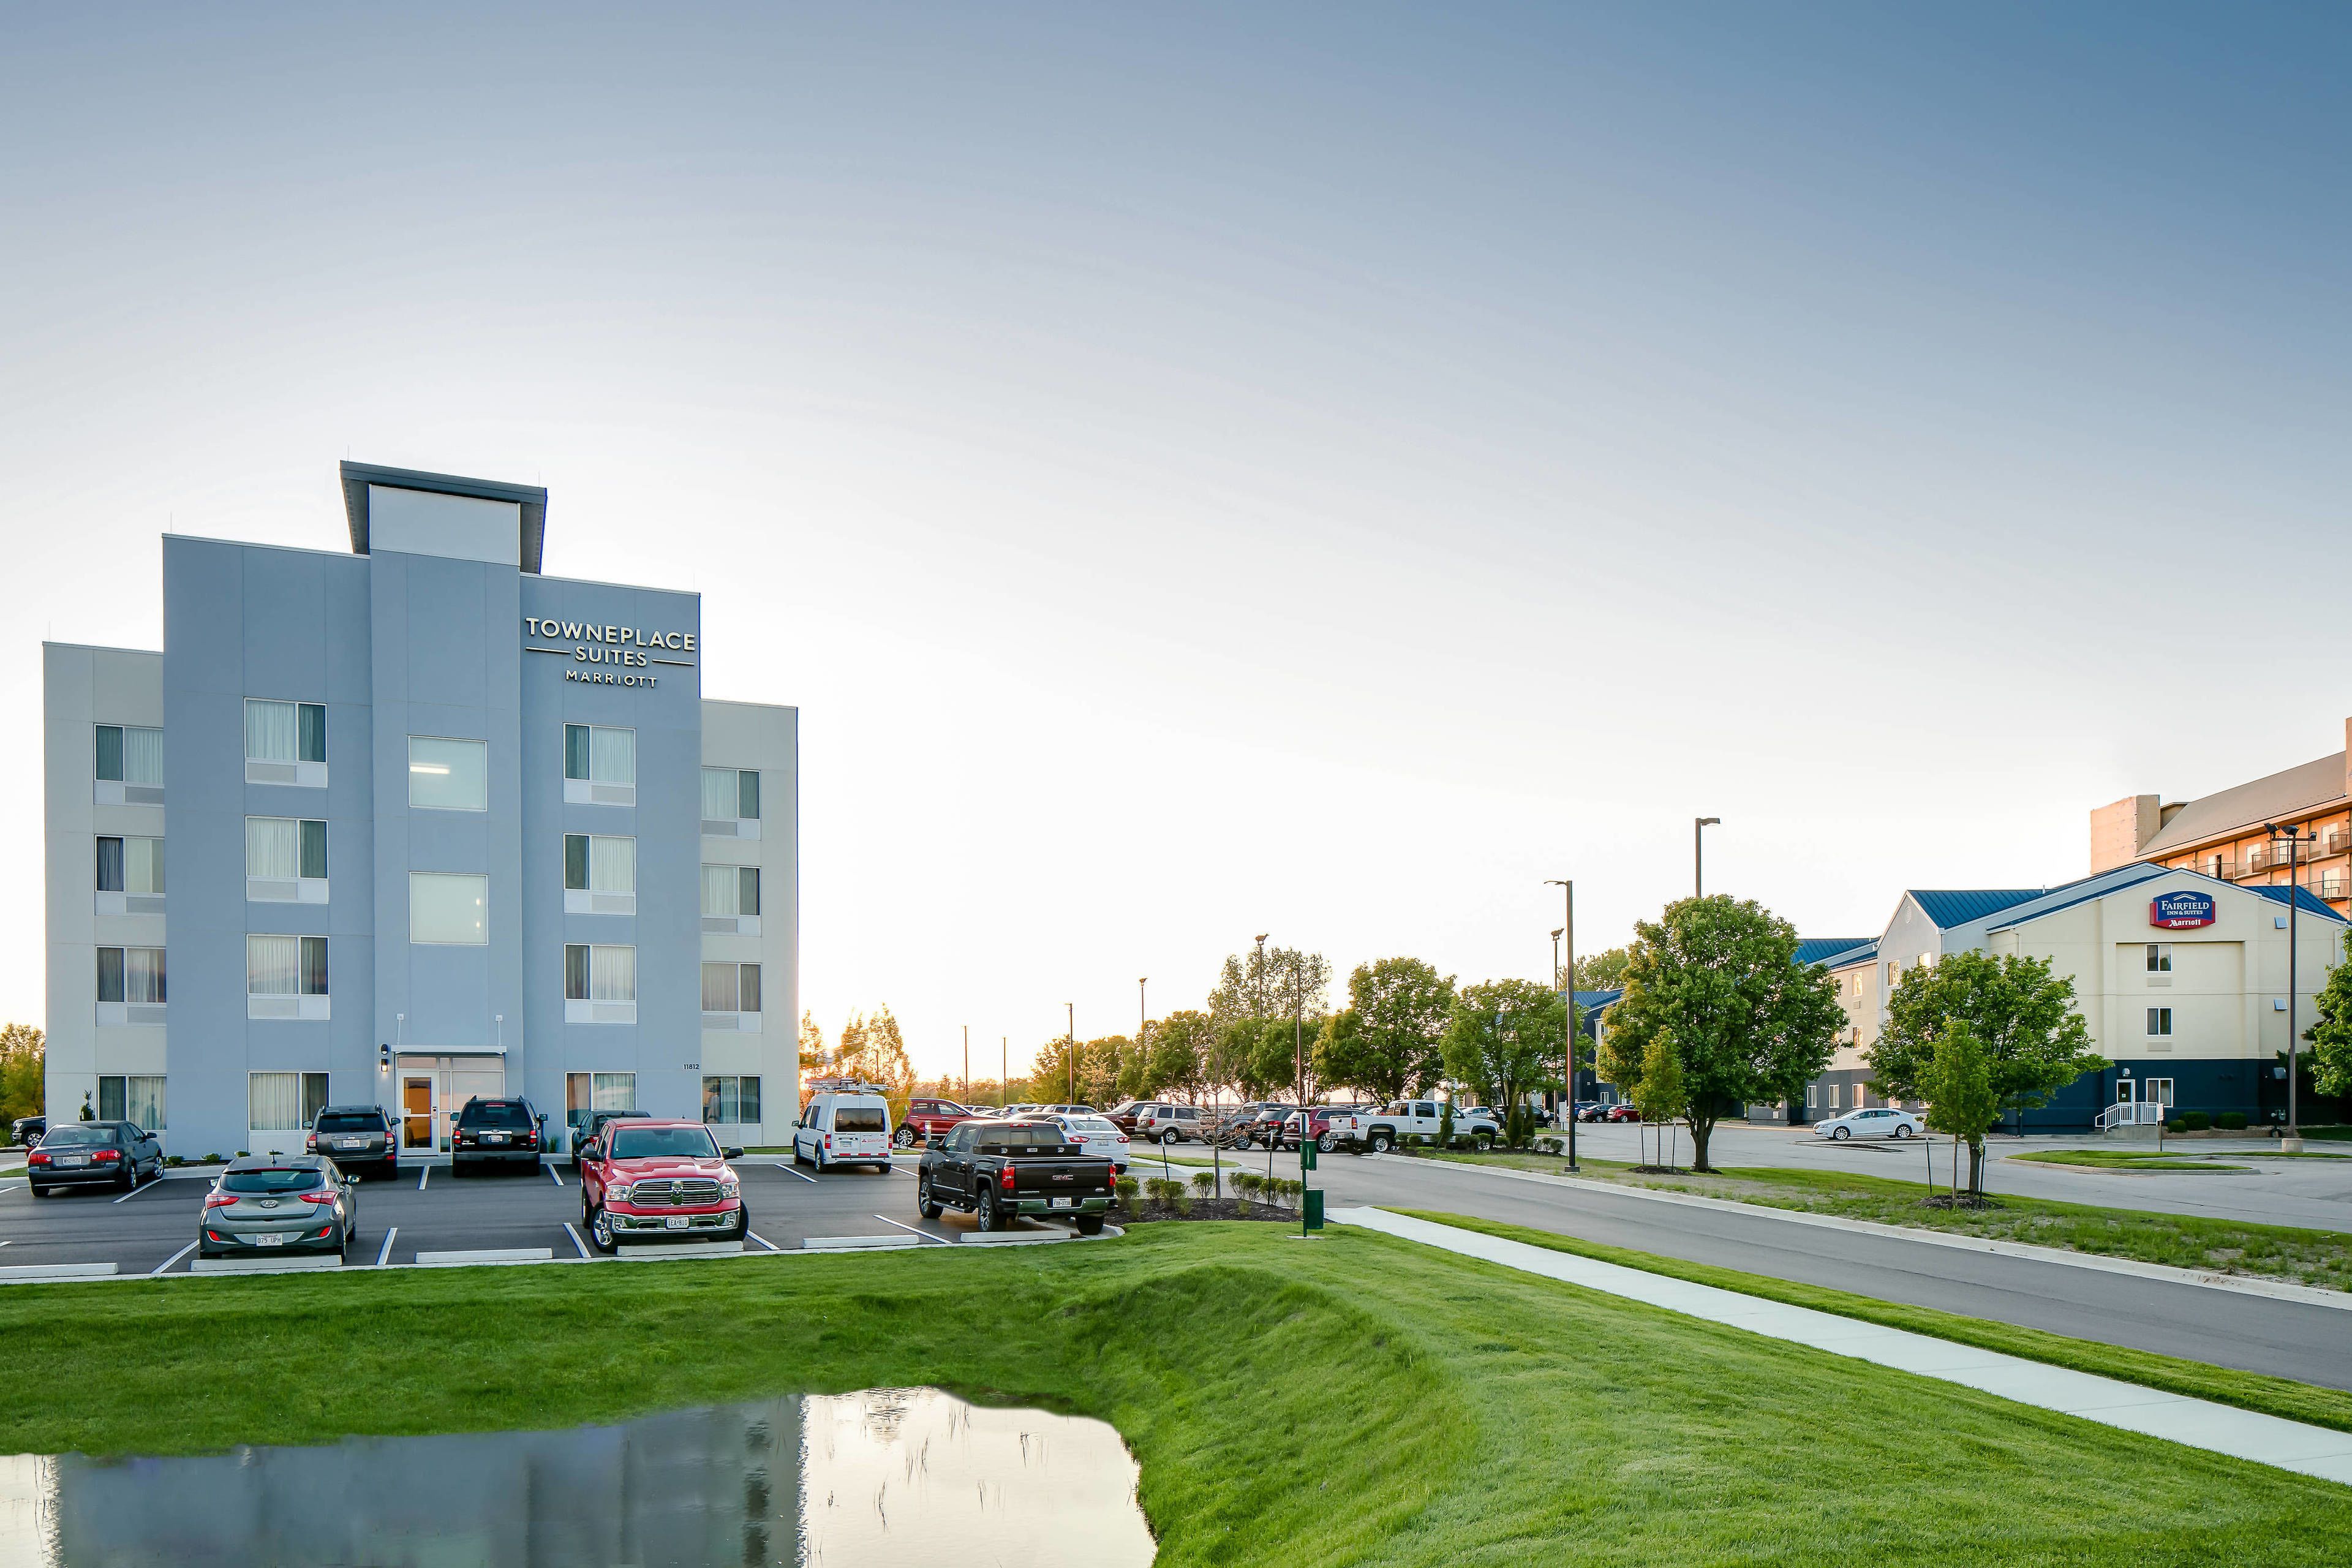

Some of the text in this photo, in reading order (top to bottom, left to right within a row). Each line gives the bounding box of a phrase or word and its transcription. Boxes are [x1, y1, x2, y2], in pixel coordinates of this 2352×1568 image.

[525, 617, 695, 651] TOWNEPLACE
[575, 646, 647, 667] SUITES
[565, 669, 657, 688] MARRIOTT
[2161, 900, 2210, 911] FAIRFIELD
